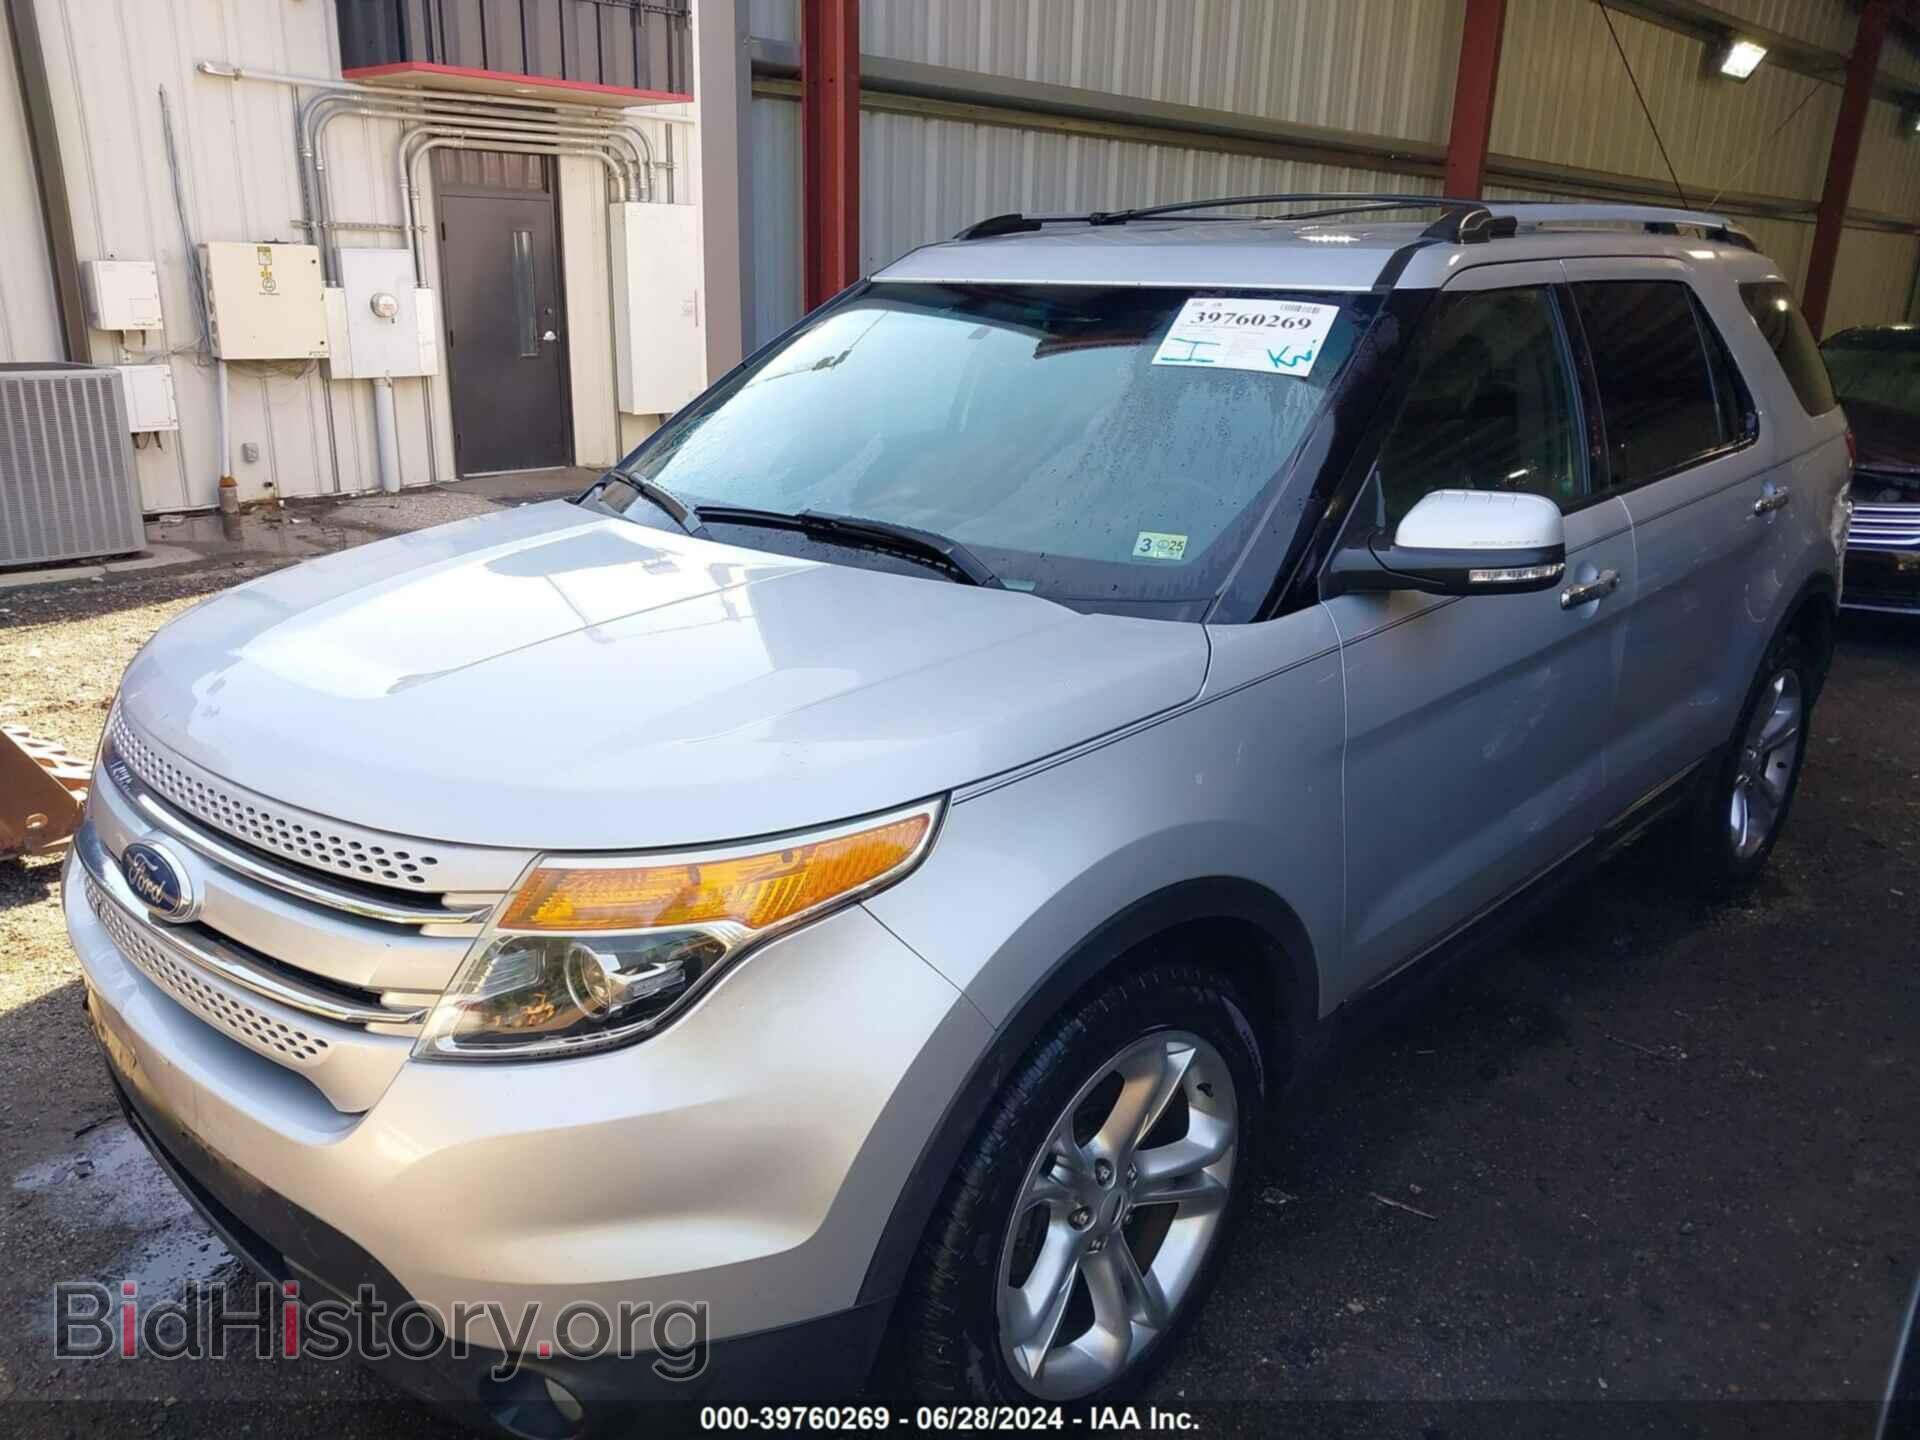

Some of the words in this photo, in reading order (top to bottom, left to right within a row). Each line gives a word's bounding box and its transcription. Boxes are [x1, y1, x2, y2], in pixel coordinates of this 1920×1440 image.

[1190, 311, 1312, 330] 39760269
[1139, 538, 1153, 552] 3
[1168, 540, 1185, 552] 25
[127, 852, 166, 904] Ford
